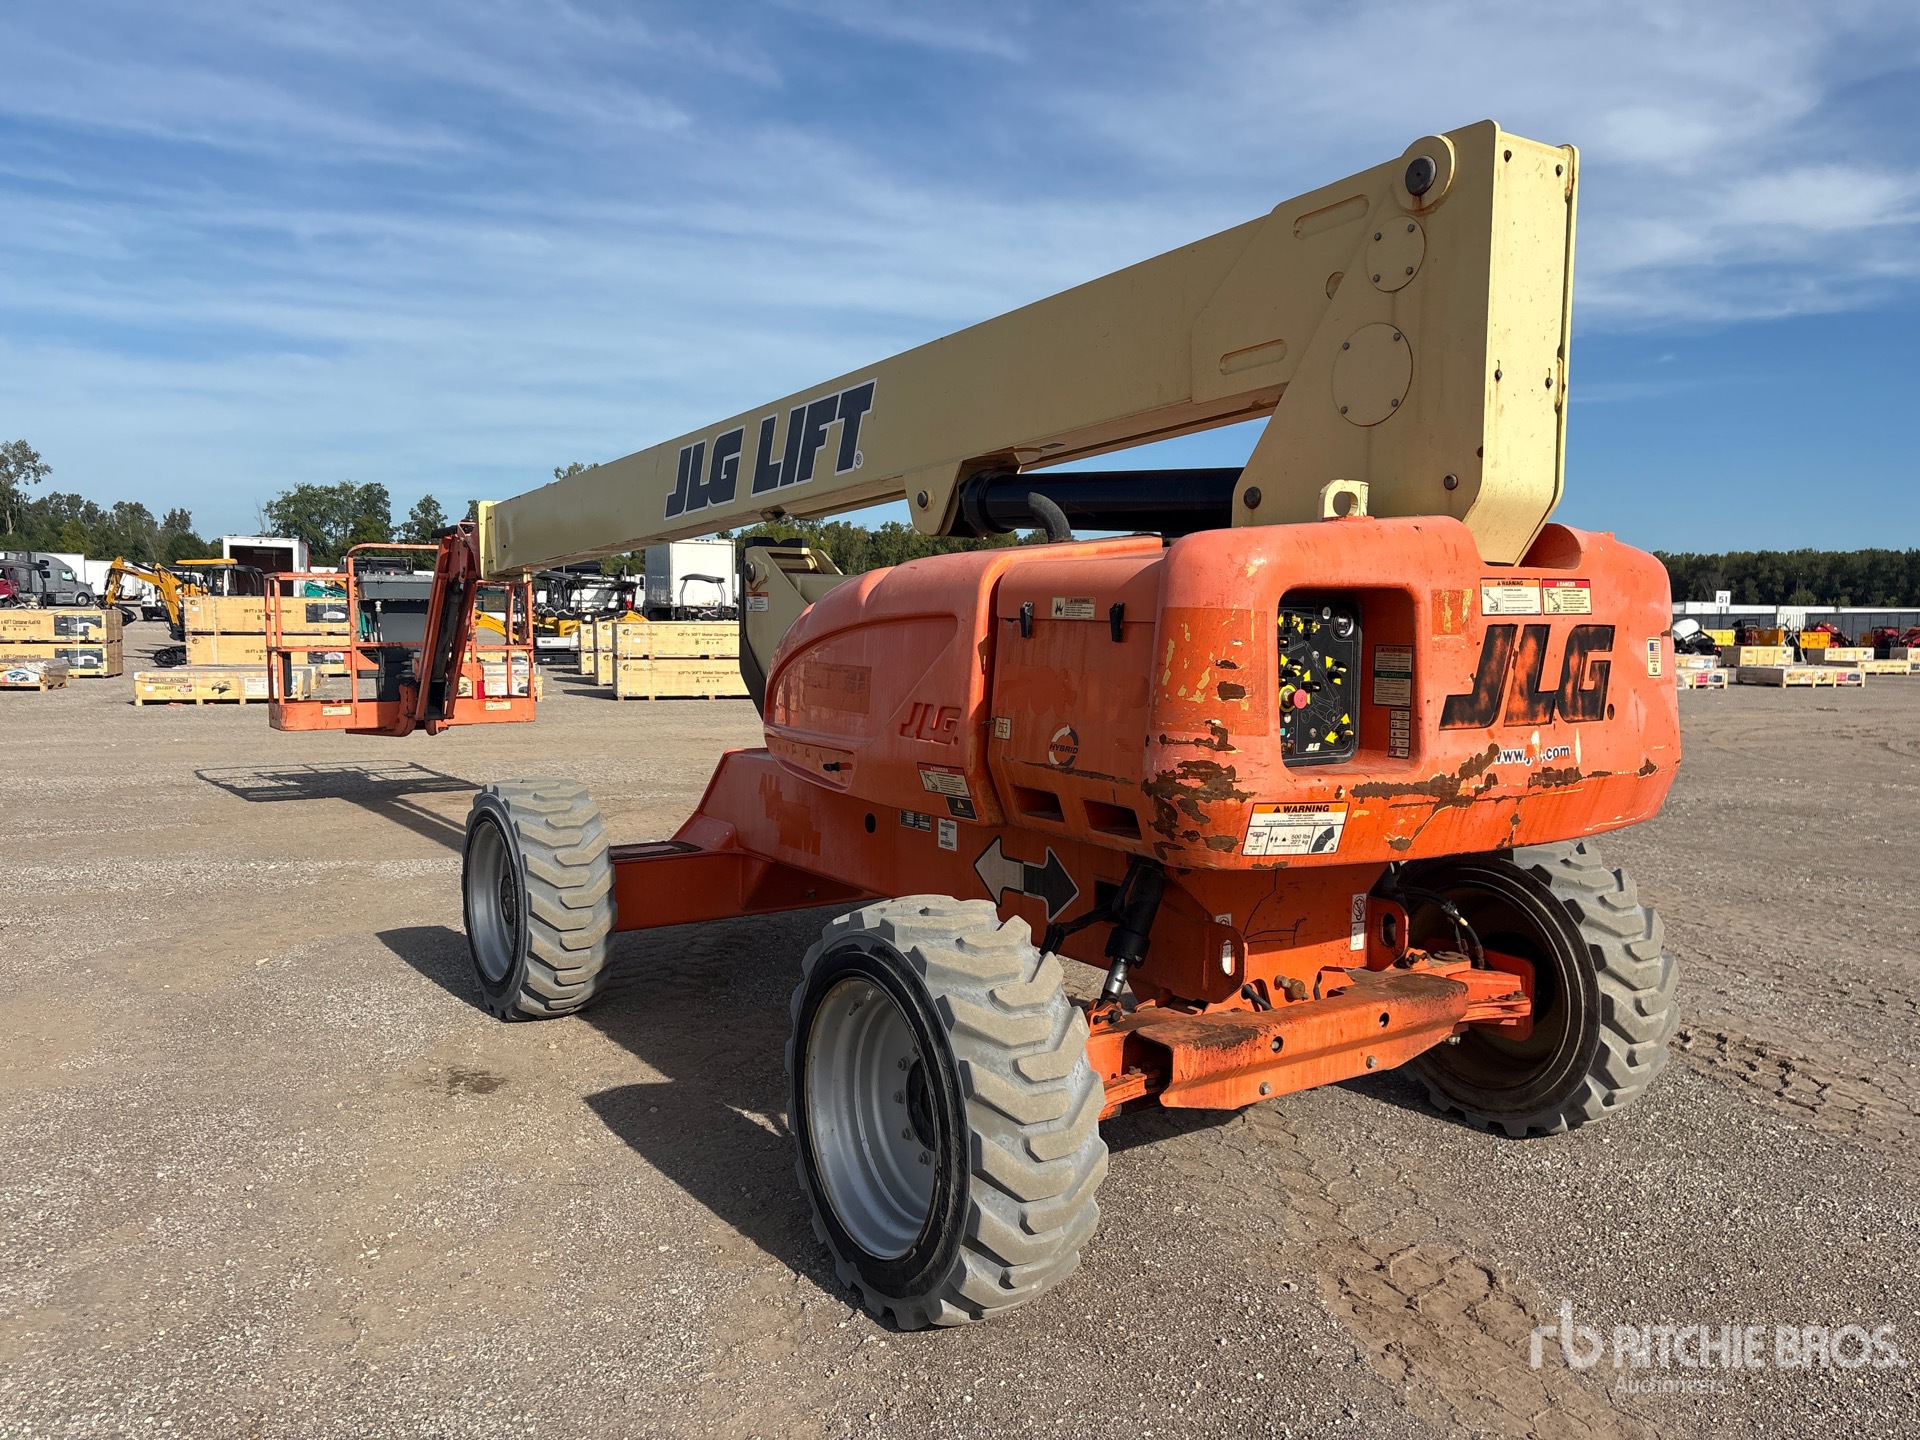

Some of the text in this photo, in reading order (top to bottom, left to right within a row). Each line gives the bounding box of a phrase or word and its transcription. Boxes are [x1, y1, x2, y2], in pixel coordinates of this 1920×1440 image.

[664, 425, 746, 520] JLG
[1049, 742, 1079, 755] HYBRID
[1305, 742, 1321, 751] JLG
[1284, 805, 1329, 813] WARNING
